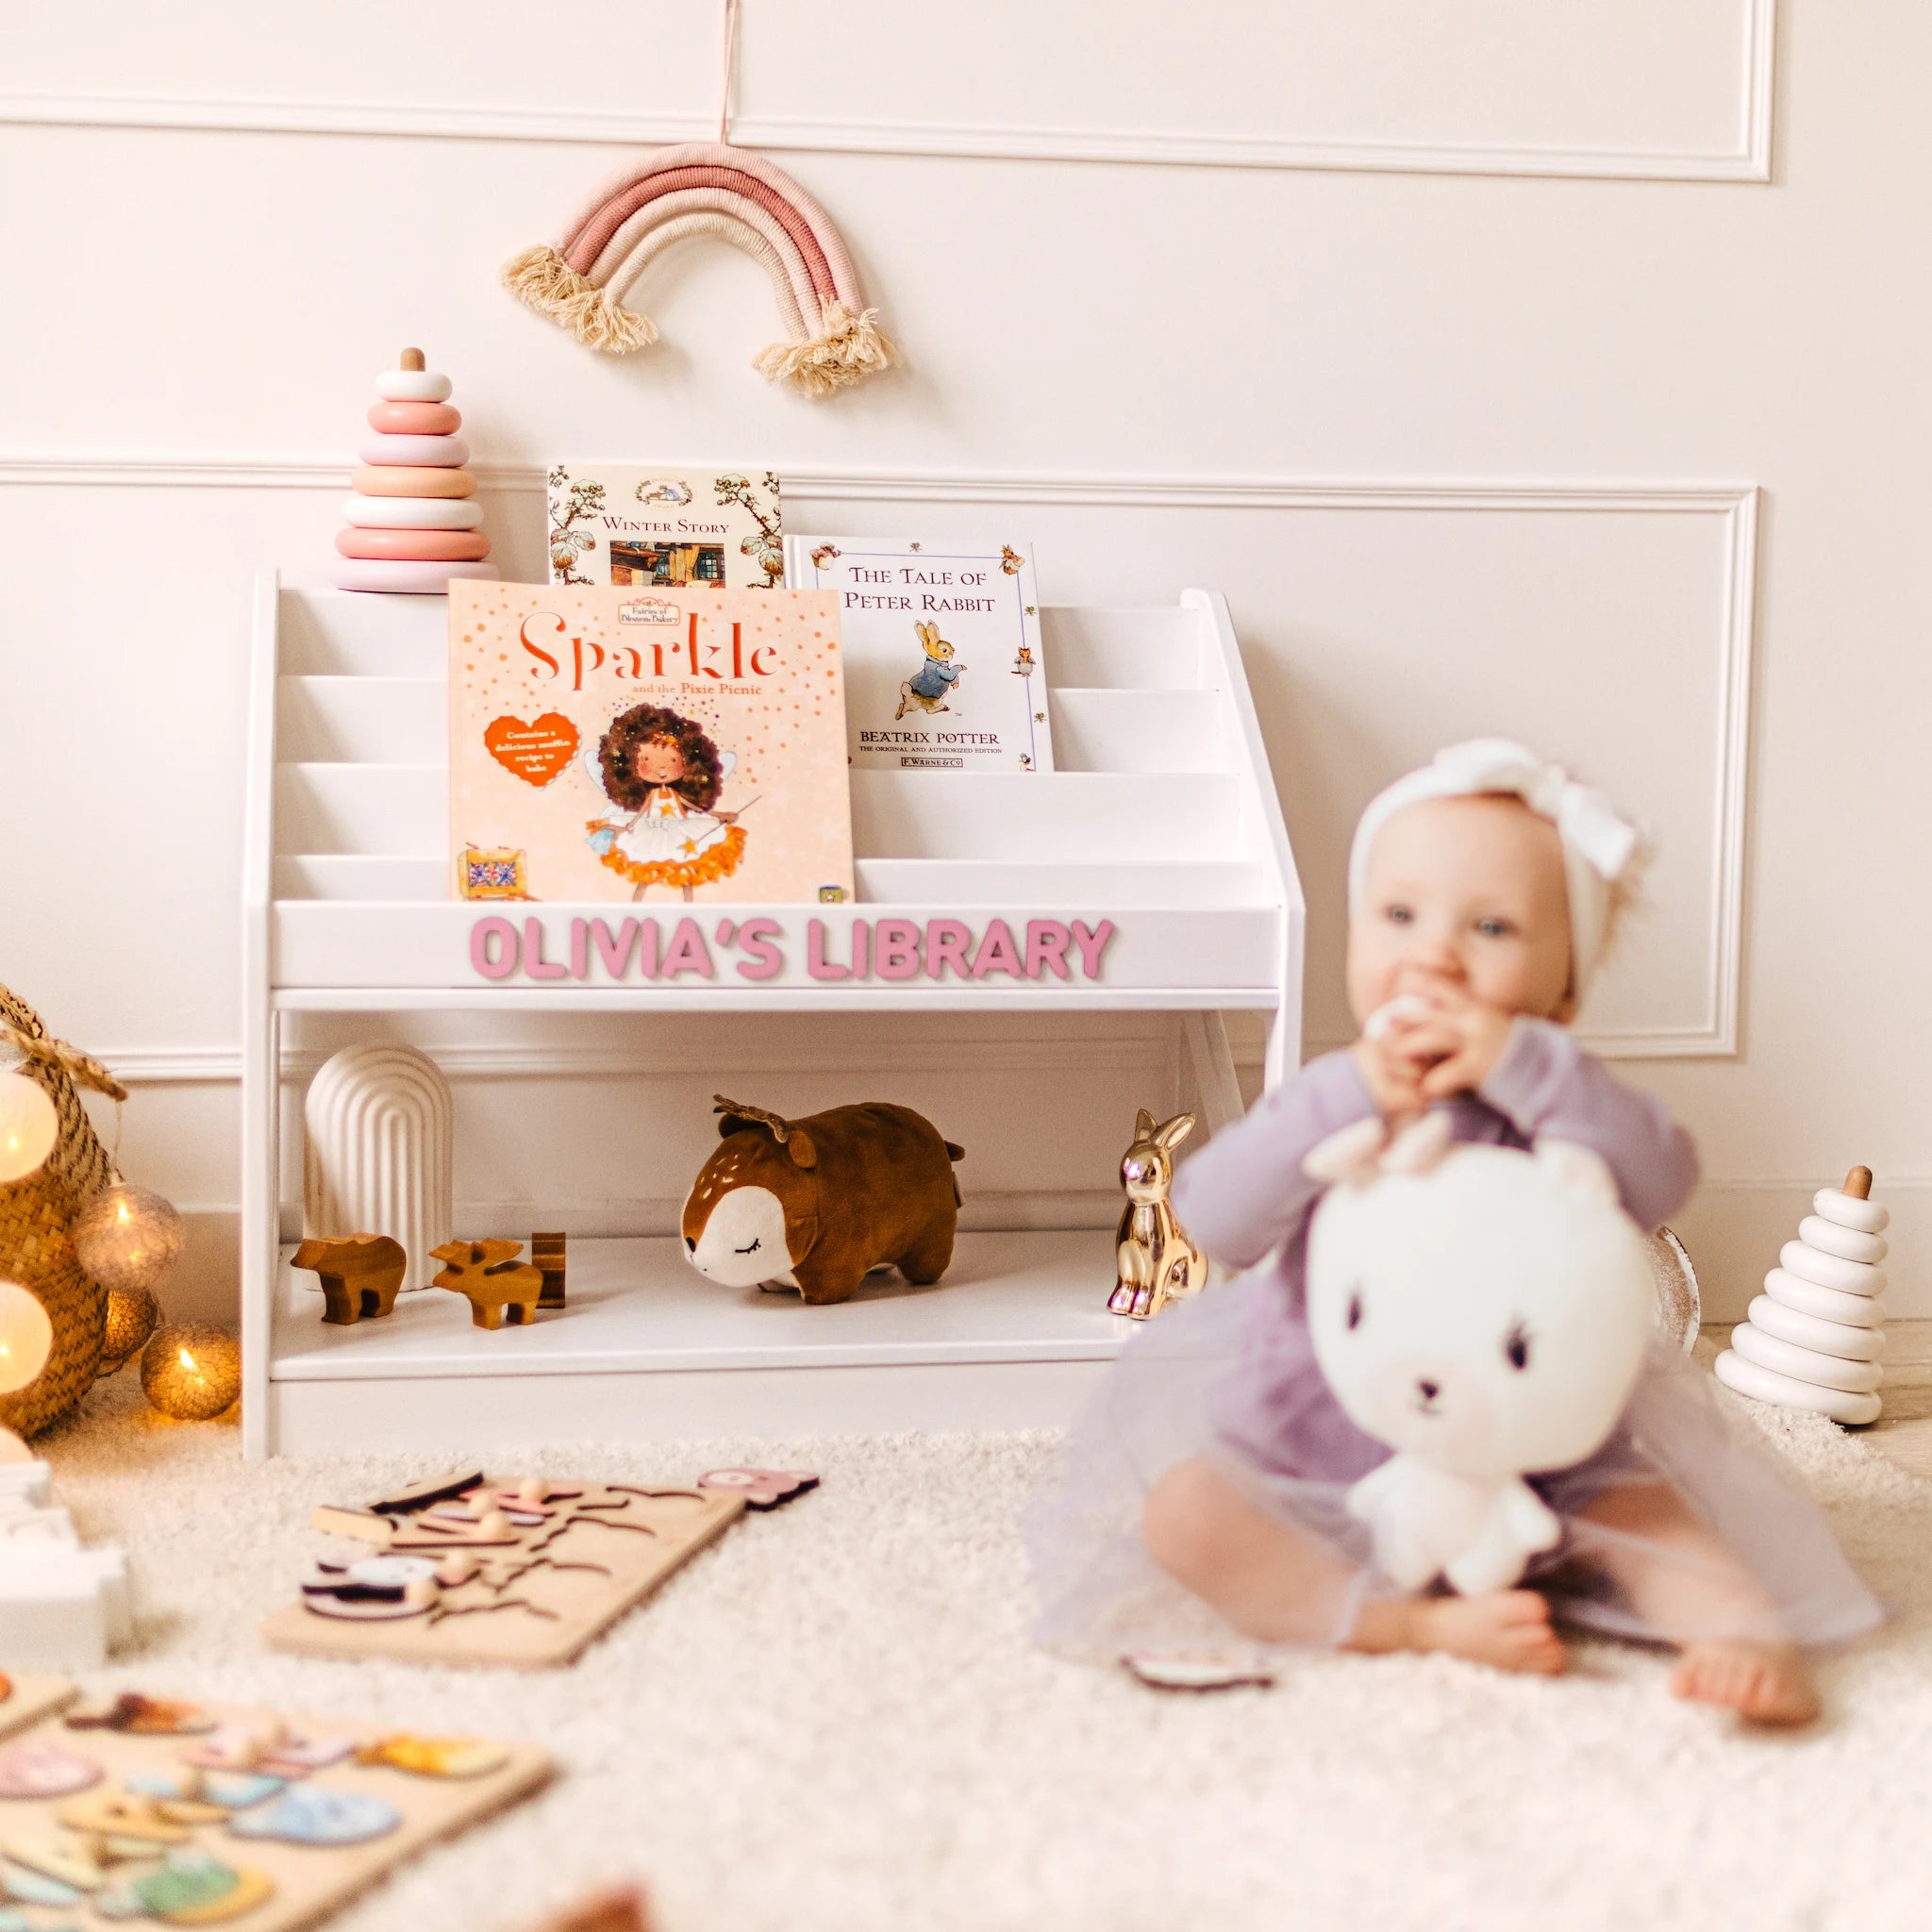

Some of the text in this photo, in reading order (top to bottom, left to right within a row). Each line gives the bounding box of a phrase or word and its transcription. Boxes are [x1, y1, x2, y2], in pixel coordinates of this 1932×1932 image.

[603, 516, 729, 534] WINTER STORY
[849, 567, 987, 586] THE TALE OF
[843, 592, 995, 612] PETER RABBIT
[520, 611, 778, 691] Sparkle
[632, 683, 762, 695] and the Pixie Picnic
[507, 730, 549, 740] Contains
[859, 731, 1000, 744] BEATRIX POTTER
[495, 739, 572, 752] delicious muffin
[515, 753, 543, 763] recipe
[807, 917, 1116, 981] LIBRARY
